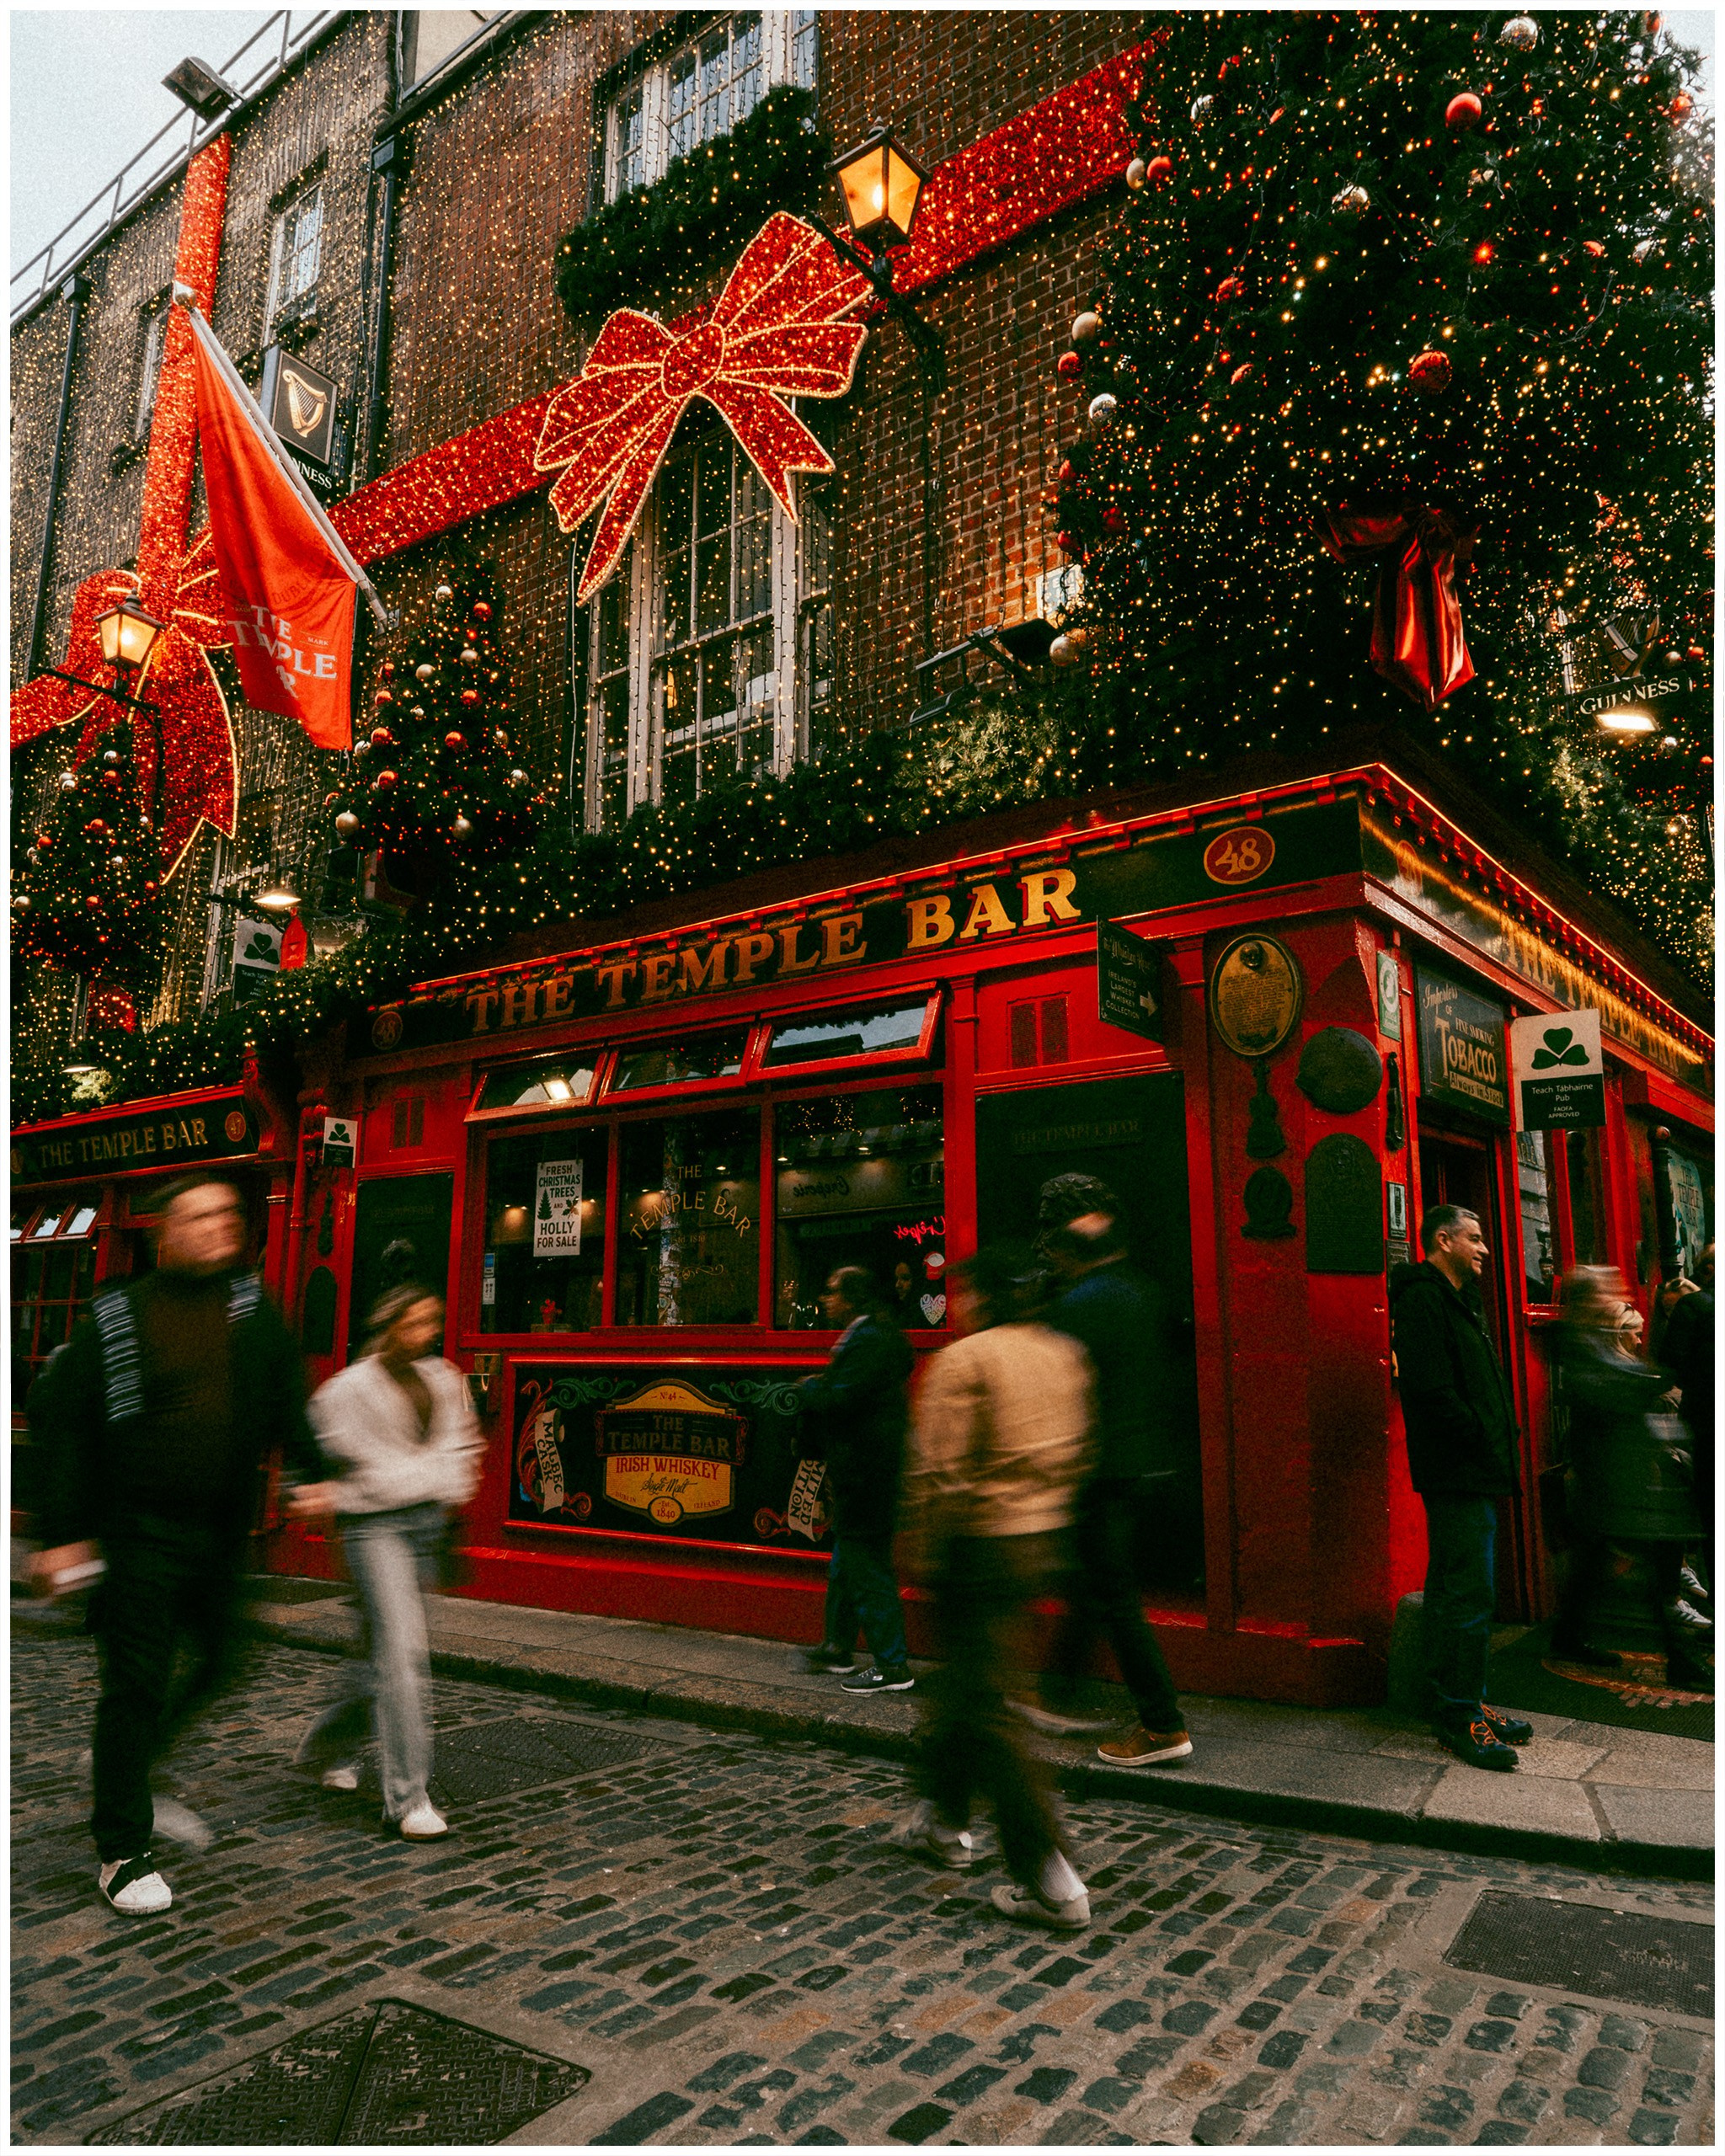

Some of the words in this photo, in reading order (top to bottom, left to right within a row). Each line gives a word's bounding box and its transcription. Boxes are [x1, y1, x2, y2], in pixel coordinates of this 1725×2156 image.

[291, 456, 332, 489] NNESS
[307, 637, 329, 646] MARK
[1215, 838, 1261, 875] 48
[466, 974, 576, 1033] THE
[597, 912, 868, 1007] TEMPLE
[904, 868, 1081, 953] BAR
[1455, 1017, 1469, 1037] FINE
[1470, 1023, 1495, 1048] SMOKING
[1434, 1016, 1497, 1084] TOBACCO
[1450, 1072, 1474, 1095] Always
[1477, 1084, 1483, 1097] in
[1485, 1086, 1503, 1106] Stock
[1532, 1086, 1553, 1095] Teach
[1556, 1083, 1594, 1093] Tábhairne
[40, 1141, 73, 1168] THE
[81, 1126, 157, 1162] TEMPLE
[161, 1118, 209, 1150] BAR
[539, 1174, 581, 1188] CHRISTMAS
[546, 1164, 573, 1176] FRESH
[677, 1165, 702, 1179] THE
[550, 1187, 575, 1198] TREES
[540, 1221, 574, 1235] HOLLY
[630, 1191, 706, 1240] TEMPLE
[713, 1195, 751, 1238] BAR
[537, 1237, 553, 1248] FOR
[556, 1235, 577, 1247] SALE
[653, 1415, 684, 1432] THE
[543, 1422, 563, 1494] MALBEC
[606, 1431, 684, 1452] TEMPLE
[691, 1434, 732, 1459] BAR
[537, 1438, 553, 1483] CASK
[616, 1456, 650, 1474] IRISH
[654, 1457, 721, 1481] WHISKEY
[640, 1472, 666, 1496] Single
[665, 1477, 698, 1499] Malt
[614, 1491, 637, 1503] DUBLIN
[693, 1498, 722, 1510] IRELAND
[656, 1506, 676, 1519] 1840
